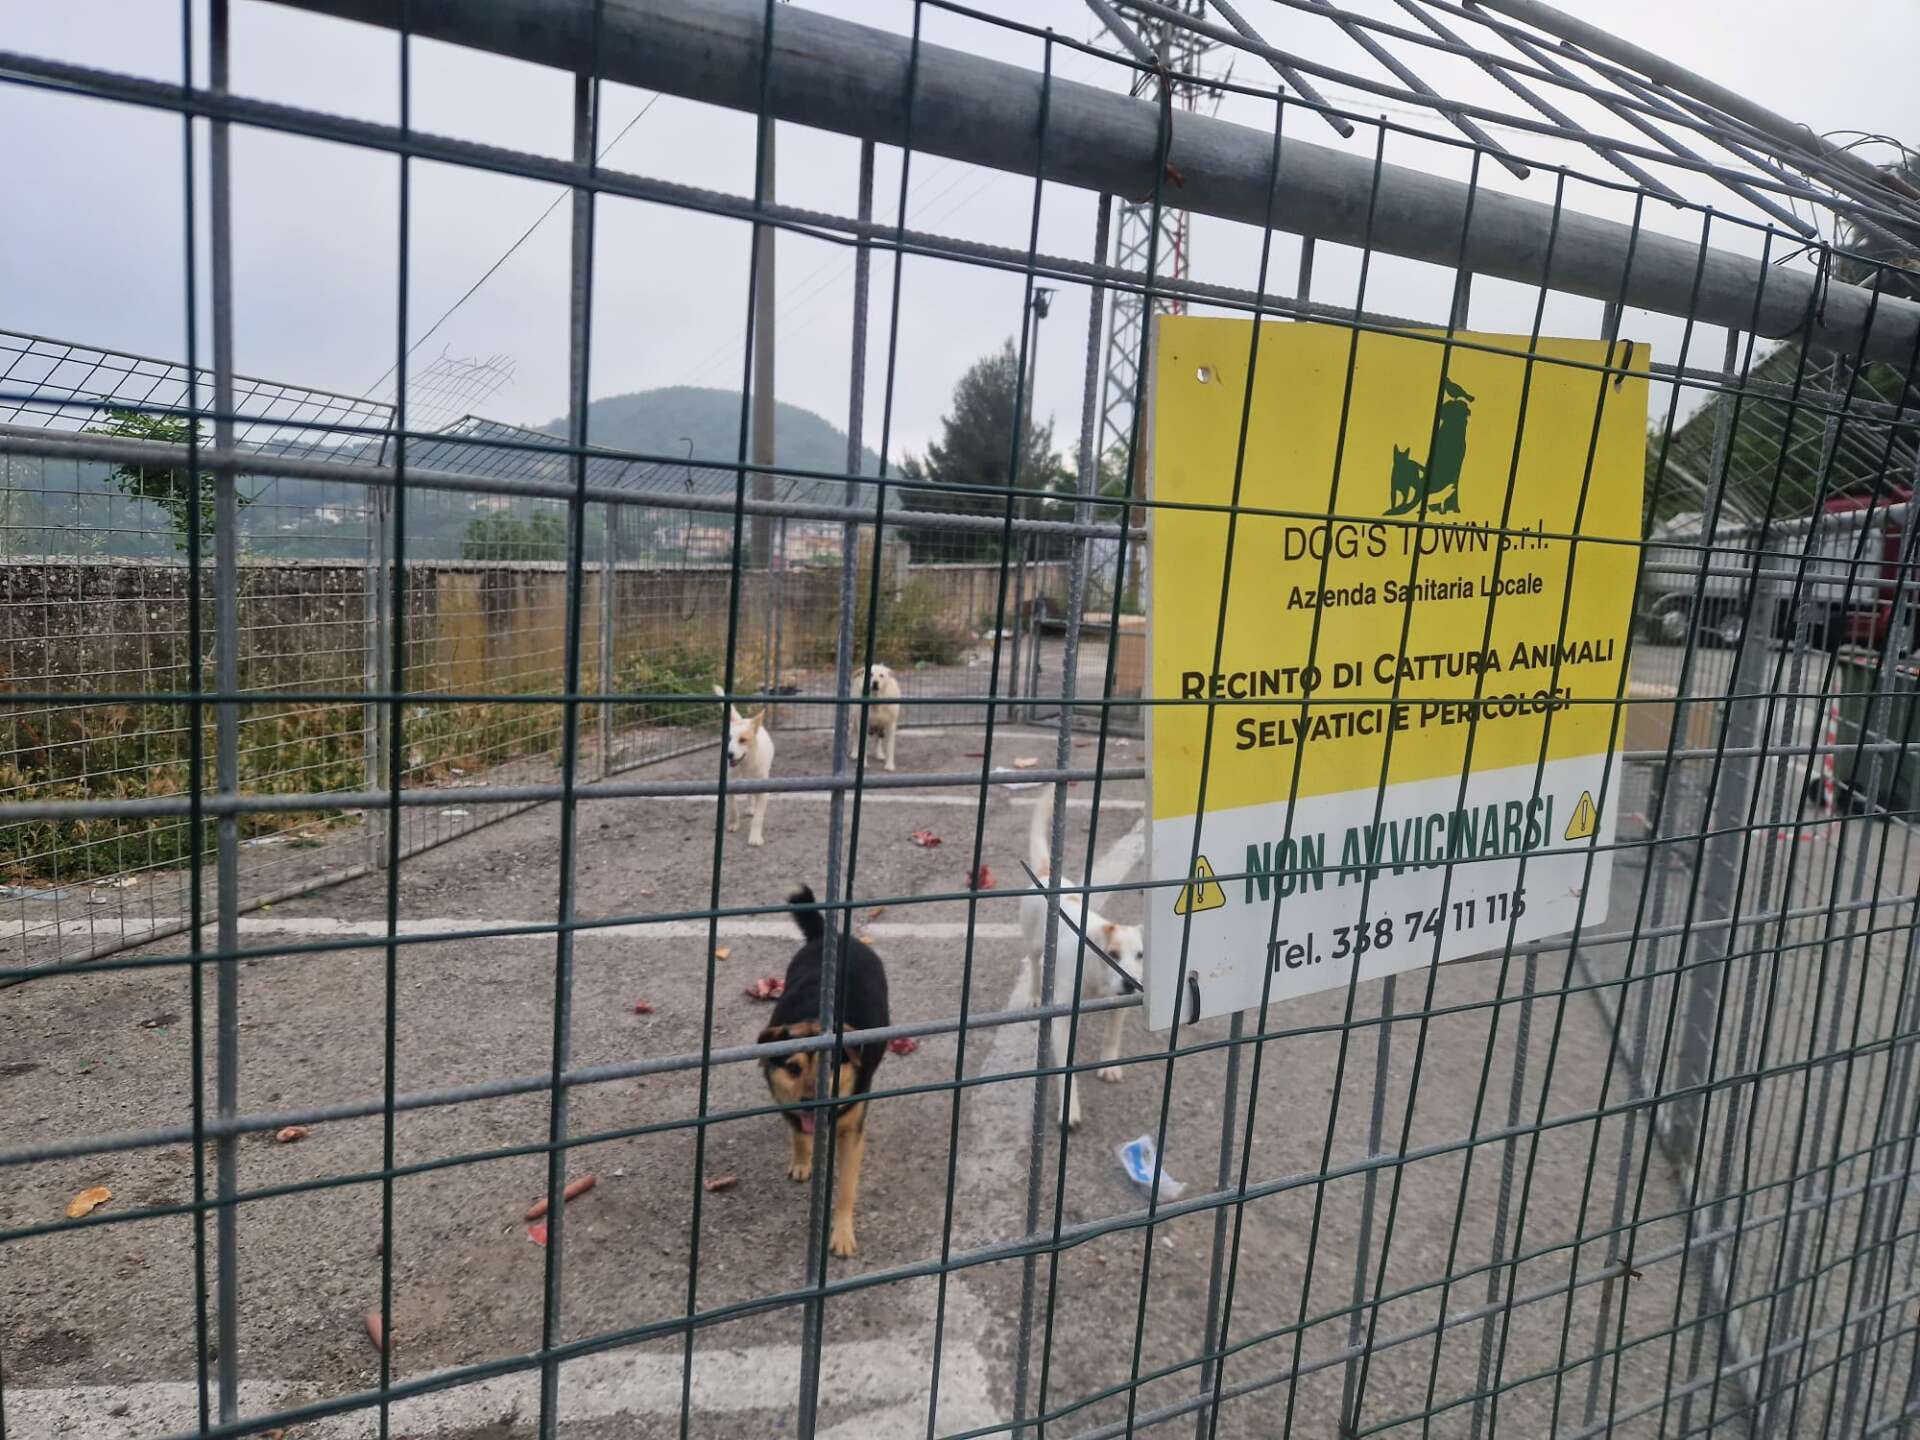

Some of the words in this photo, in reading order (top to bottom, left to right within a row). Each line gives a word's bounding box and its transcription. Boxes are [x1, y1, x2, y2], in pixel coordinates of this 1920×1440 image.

[1284, 524, 1386, 560] DOG'S
[1396, 520, 1488, 555] TOWN
[1287, 582, 1376, 610] Azenda
[1383, 576, 1473, 604] Sanitaria
[1480, 573, 1543, 597] Locale
[1182, 666, 1322, 700] RECINTO
[1333, 662, 1362, 688] DI
[1235, 708, 1382, 751] SELVATICI
[1391, 705, 1409, 731] E
[1245, 833, 1325, 904] NON
[1338, 795, 1554, 886] AVVICINARSI
[1267, 932, 1321, 972] Tel.
[1331, 918, 1393, 959] 338
[1405, 908, 1441, 942] 74
[1453, 899, 1476, 931] 11
